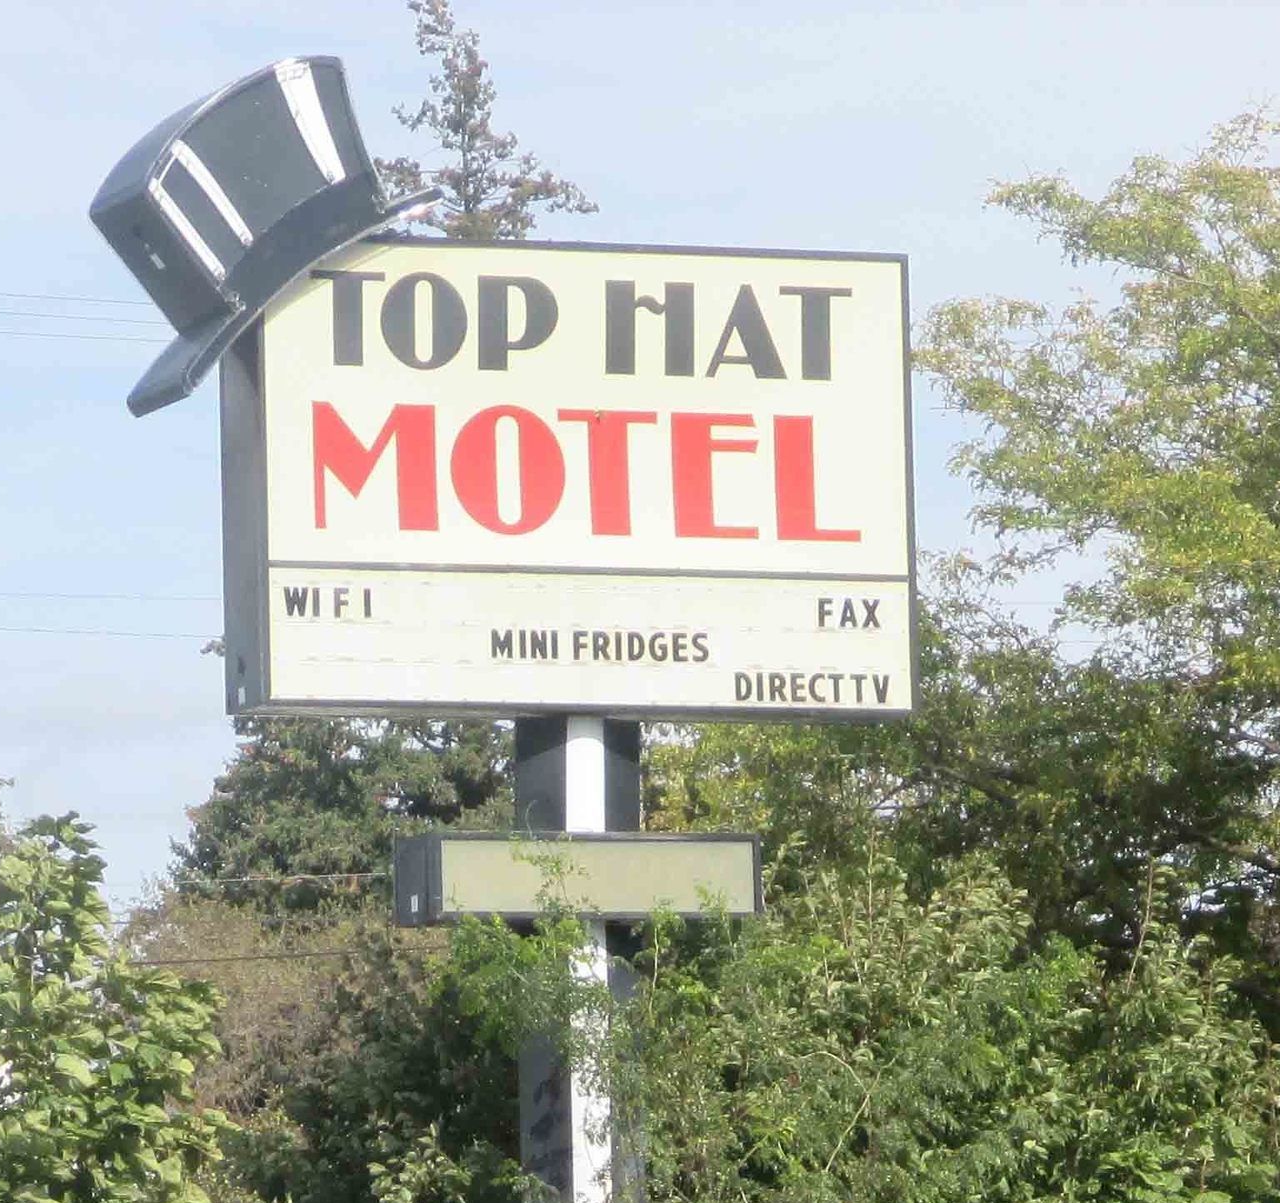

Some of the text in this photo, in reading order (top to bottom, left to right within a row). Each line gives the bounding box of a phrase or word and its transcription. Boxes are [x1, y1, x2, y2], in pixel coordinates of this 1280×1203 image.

[311, 269, 853, 382] TOP HAT
[311, 401, 862, 543] MOTEL
[490, 628, 710, 663] MINI FRIDGES
[818, 597, 880, 629] FAX
